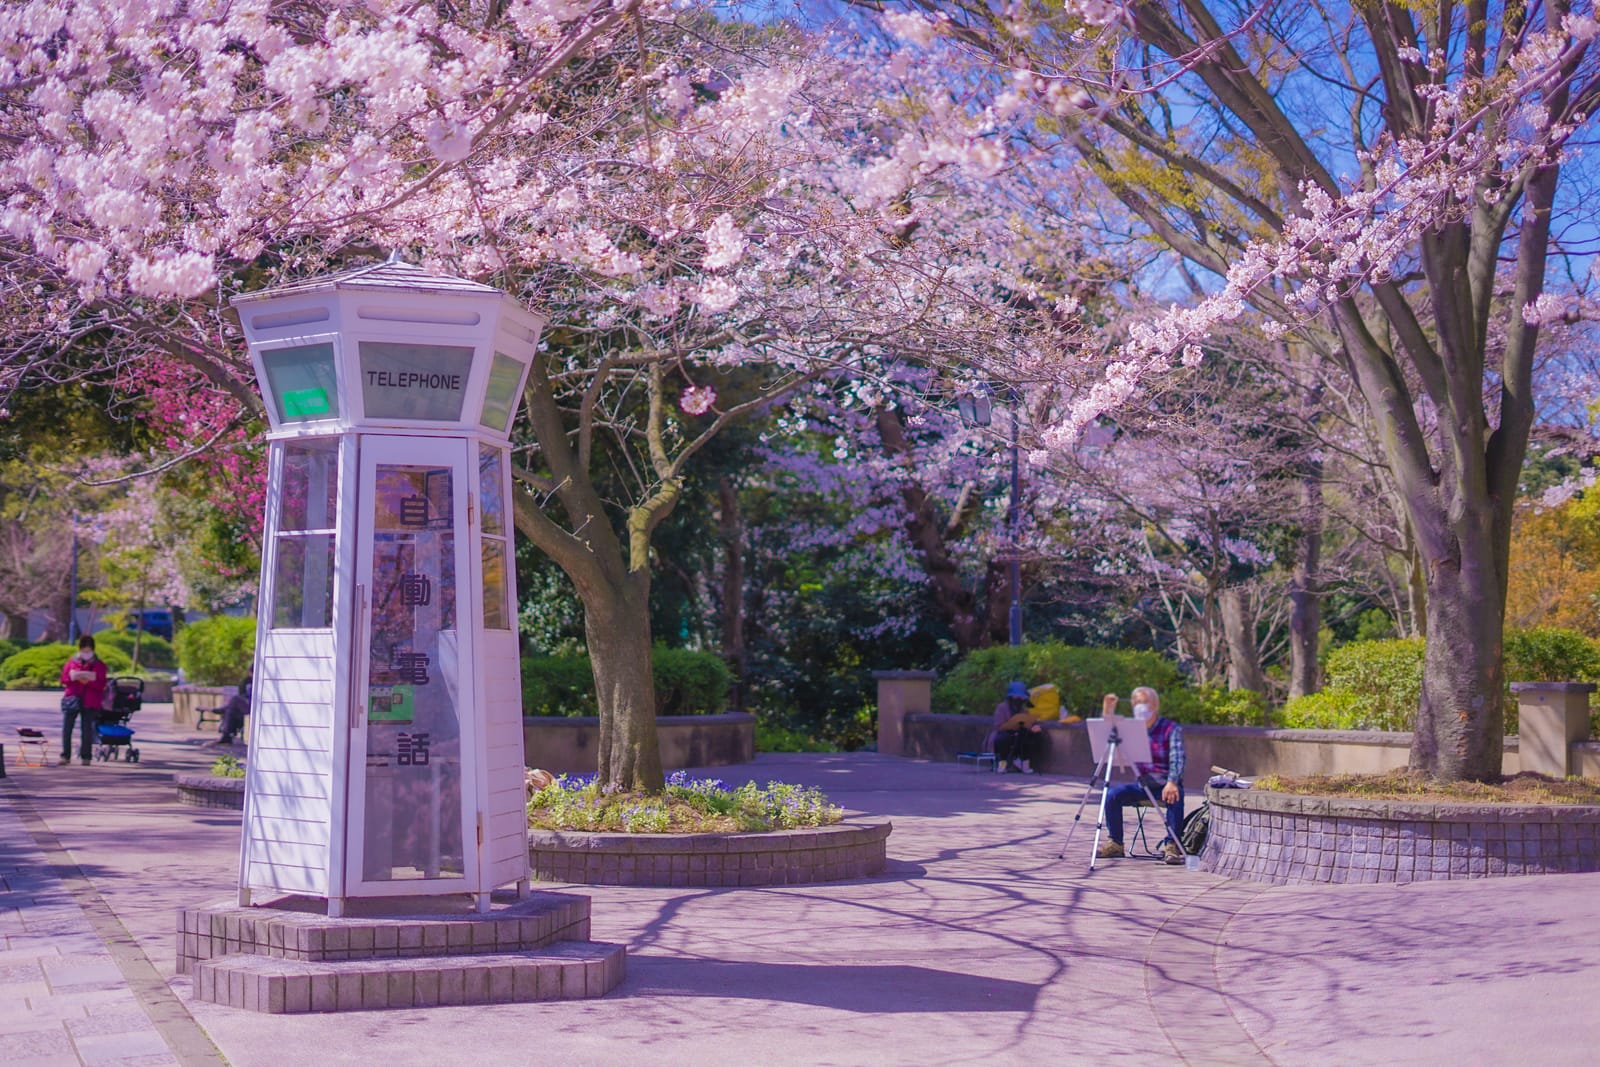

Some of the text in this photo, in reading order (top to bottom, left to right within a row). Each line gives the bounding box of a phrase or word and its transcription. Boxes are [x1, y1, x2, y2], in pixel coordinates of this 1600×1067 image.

[367, 371, 460, 390] TELEPHONE
[397, 494, 431, 766] 自働電話
